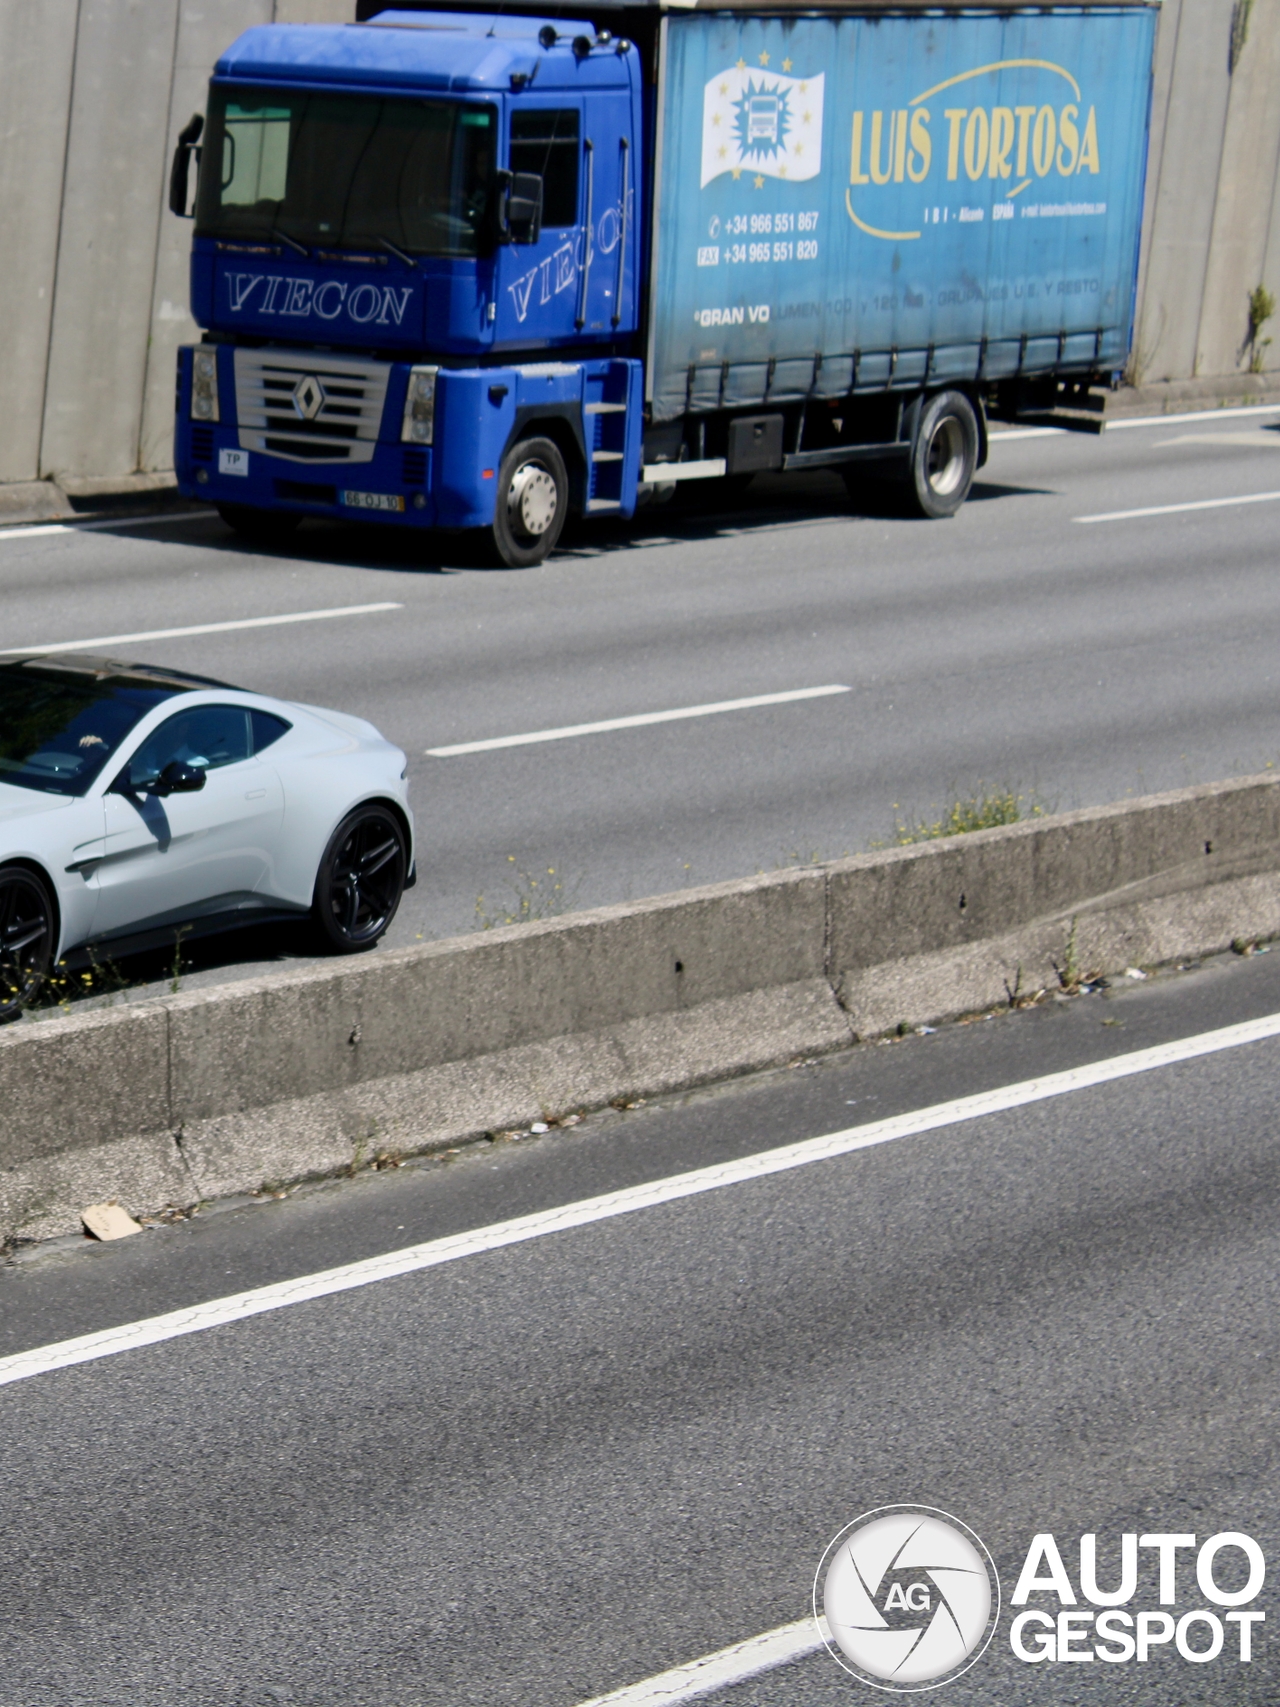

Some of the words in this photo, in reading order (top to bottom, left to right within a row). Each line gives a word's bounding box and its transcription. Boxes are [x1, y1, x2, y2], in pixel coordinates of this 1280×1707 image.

[850, 107, 932, 185] LUIS
[943, 104, 1100, 181] TORTOSA
[725, 215, 747, 234] +34
[750, 213, 772, 234] 966
[774, 212, 794, 233] 551
[798, 211, 819, 231] 867
[699, 248, 718, 264] FAX
[724, 243, 746, 264] +34
[749, 242, 771, 263] 965
[773, 241, 793, 262] 551
[797, 240, 818, 260] 820
[224, 271, 414, 326] VIECON
[700, 306, 744, 327] GRAN
[226, 453, 241, 465] TP
